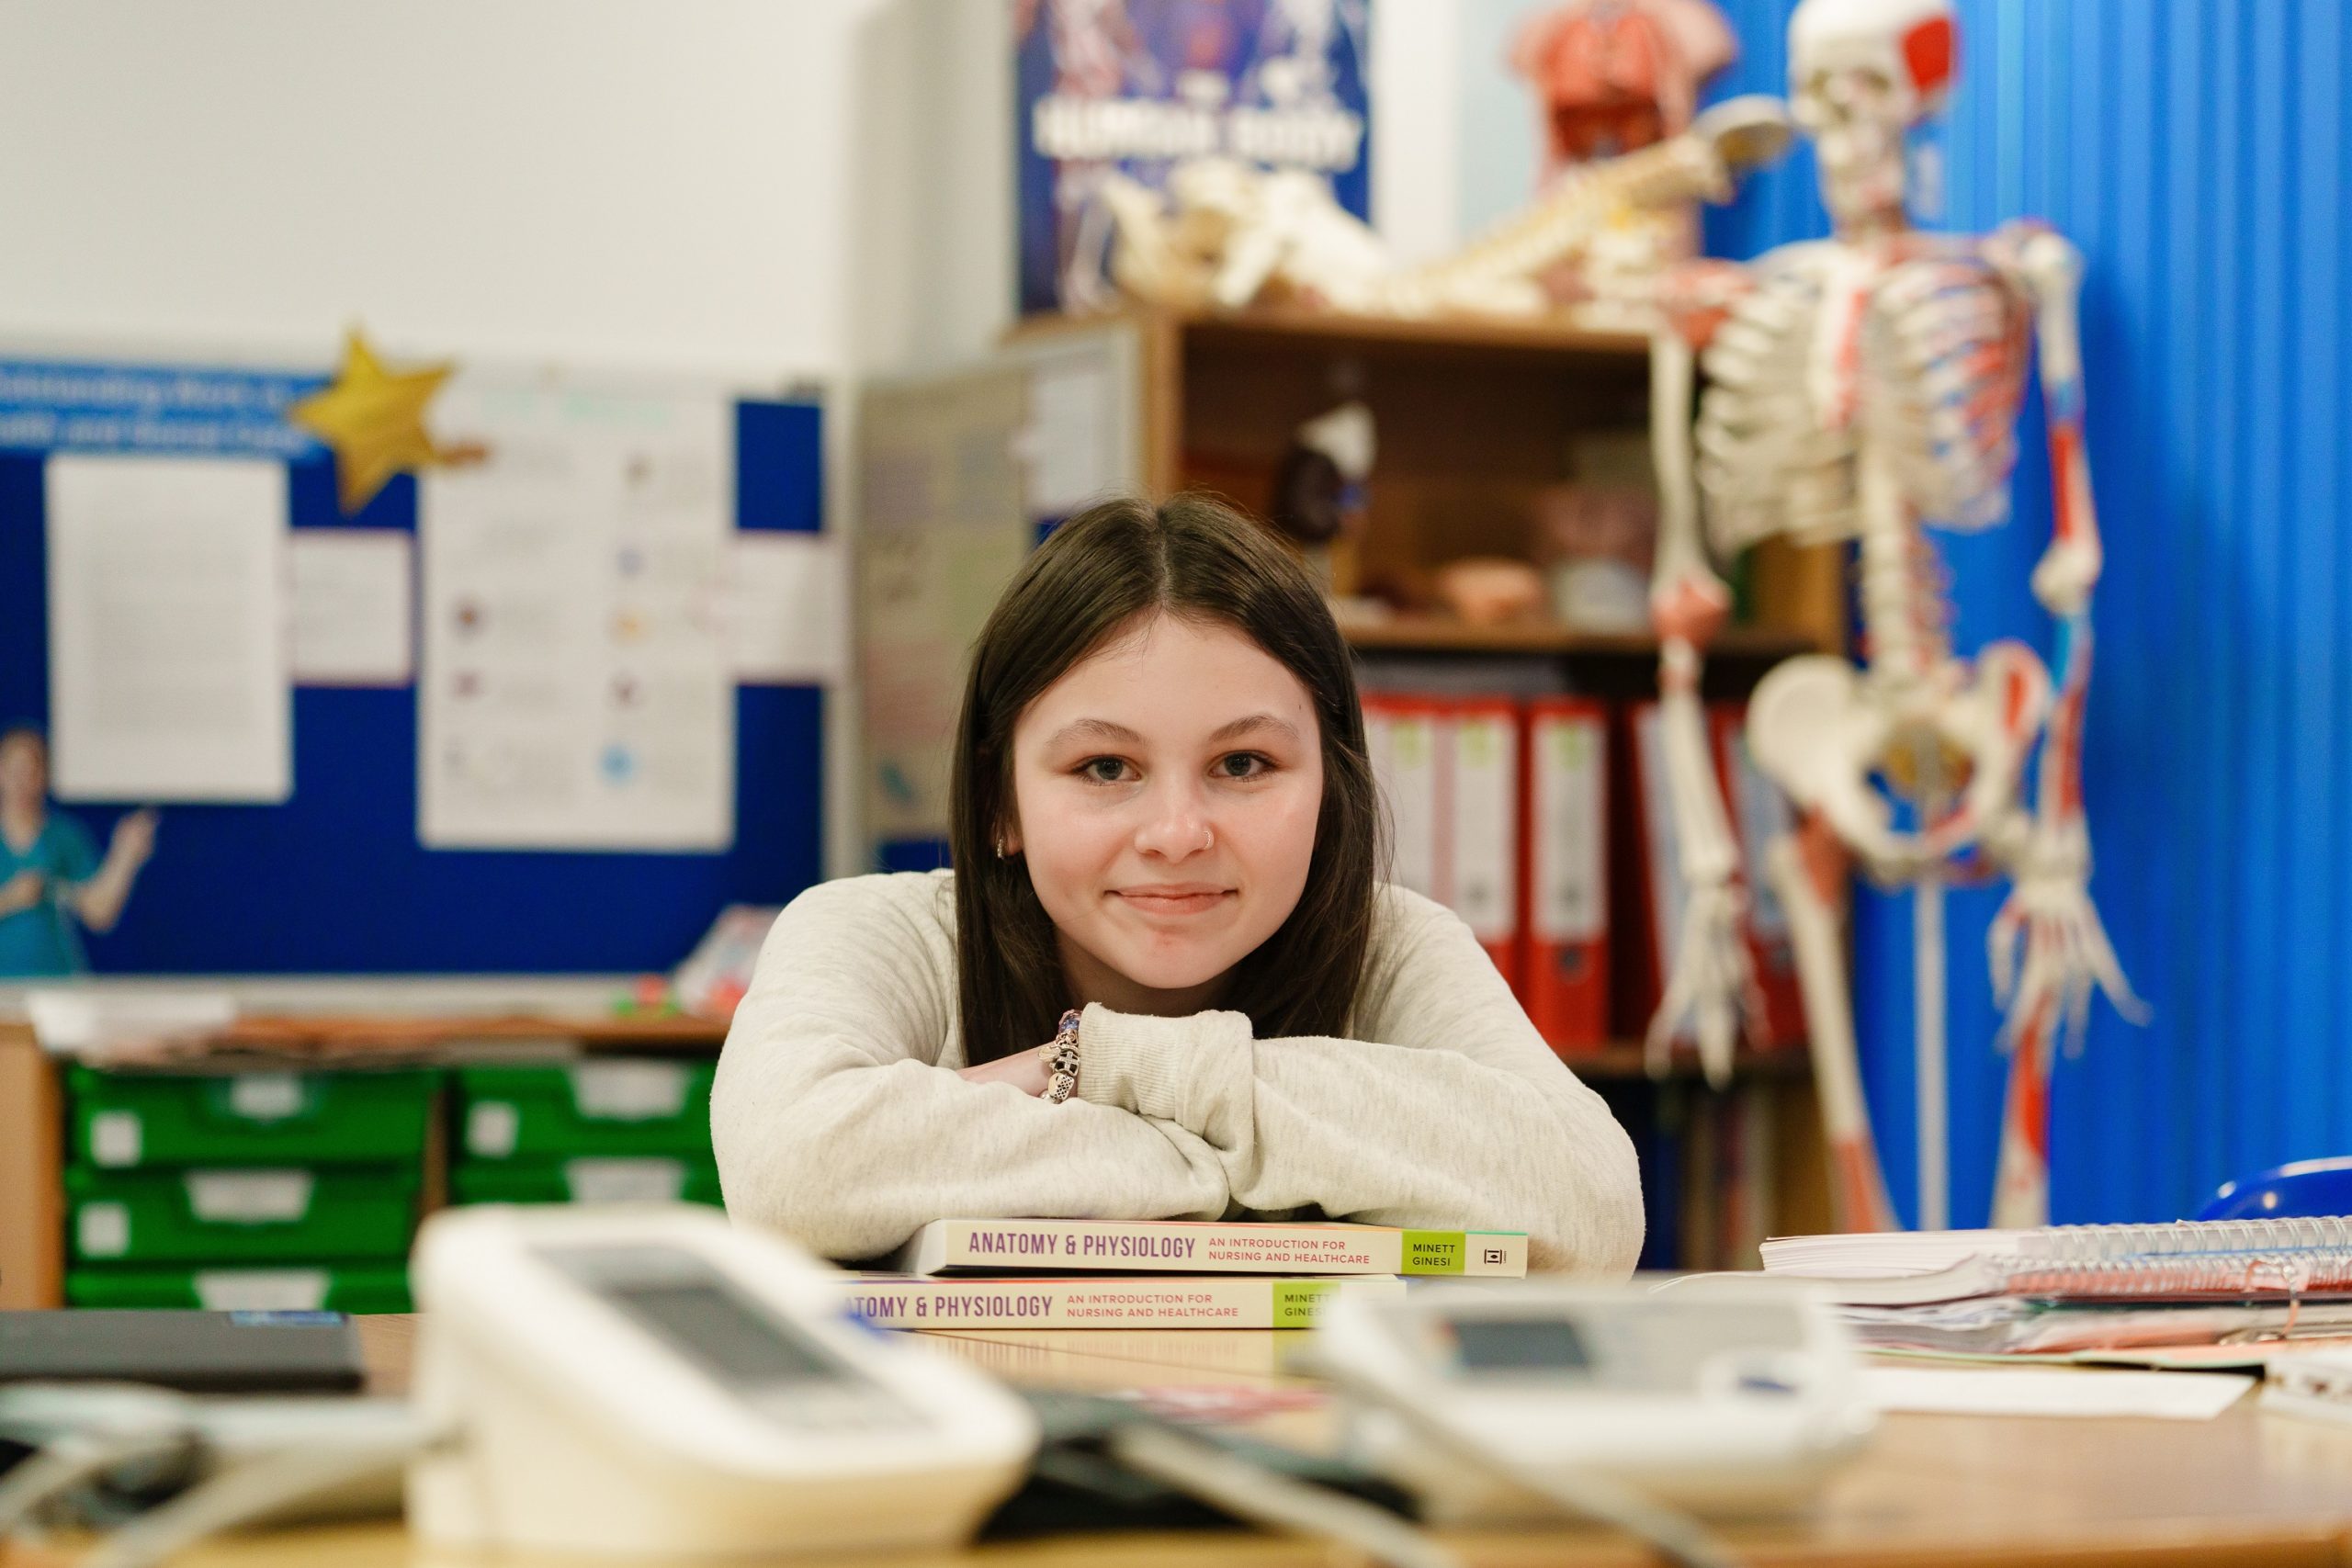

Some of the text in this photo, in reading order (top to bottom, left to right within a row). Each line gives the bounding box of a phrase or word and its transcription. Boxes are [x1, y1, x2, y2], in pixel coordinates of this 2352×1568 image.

[968, 1232, 1196, 1258] ANATOMY & PHYSIOLOGY
[1208, 1237, 1346, 1250] AN INTRODUCTION FOR
[1412, 1244, 1456, 1254] MINETT
[1208, 1251, 1370, 1264] NURSING AND HEALTHCARE
[1412, 1257, 1451, 1267] GINESI
[1067, 1294, 1213, 1304] AN INTRODUCTION FOR
[844, 1295, 1053, 1317] ATOMY & PHYSIOLOGY
[1067, 1307, 1239, 1317] NURSING AND HEALTHCARE
